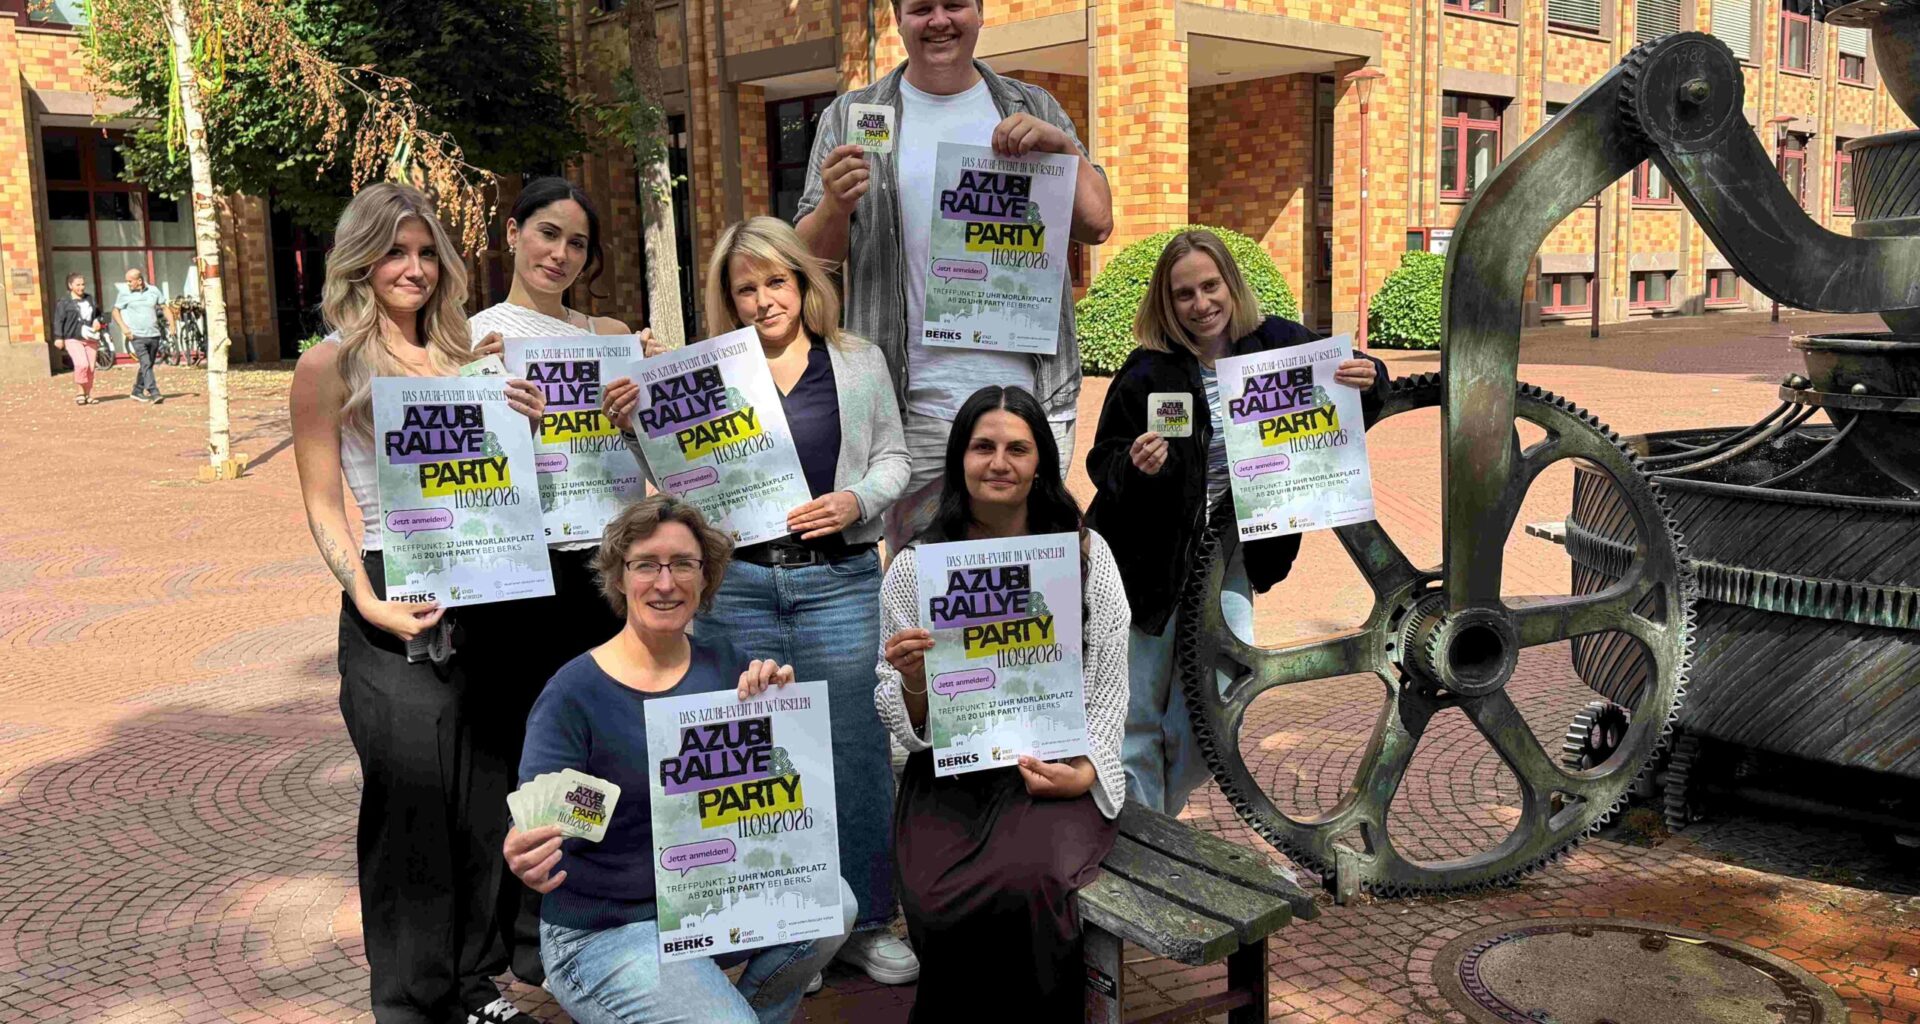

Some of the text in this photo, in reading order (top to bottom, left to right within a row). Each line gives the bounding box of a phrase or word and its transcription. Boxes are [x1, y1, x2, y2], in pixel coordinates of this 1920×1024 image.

[956, 171, 1030, 197] AZUBI
[939, 190, 1028, 217] RALLYE
[964, 221, 1044, 246] PARTY
[990, 248, 1049, 269] 11.09.2026
[1002, 293, 1051, 303] MORLAIXPLATZ
[925, 329, 961, 340] BERKS
[526, 361, 600, 384] AZUBI
[1242, 366, 1312, 396] AZUBI
[402, 390, 417, 401] DAS
[538, 383, 600, 405] LLYE
[650, 365, 723, 406] AZUBI
[638, 387, 726, 433] RALLYE
[1228, 385, 1313, 418] RALLYE
[402, 405, 482, 430] AZUBI
[540, 410, 615, 435] PART
[675, 406, 754, 453] PARTY
[1259, 405, 1335, 440] PARTY
[384, 429, 483, 456] RALLYE
[419, 457, 507, 488] PARTY
[453, 486, 519, 508] 11.09.2026
[710, 501, 726, 510] UHR
[726, 494, 748, 505] PARTY
[725, 488, 741, 497] UHR
[1241, 522, 1277, 534] BERKS
[392, 542, 444, 553] TREFFPUNKT:
[476, 534, 534, 545] MORLAIXPLATZ
[497, 543, 521, 552] BERKS
[945, 555, 961, 567] DAS
[946, 565, 1029, 595] AZUBI
[929, 589, 1029, 622] RALLYE
[964, 615, 1052, 650] PARTY
[996, 643, 1062, 667] 11.09.2026
[956, 675, 989, 685] anmelden!
[679, 696, 810, 724] DAS AZUBI-EVENT IN WÜRSELEN
[938, 702, 987, 715] TREFFPUNKT:
[998, 698, 1014, 706] UHR
[1017, 690, 1072, 704] MORLAIXPLATZ
[978, 710, 995, 718] UHR
[997, 706, 1020, 715] PARTY
[1036, 700, 1060, 710] BERKS
[678, 717, 771, 756] AZUBI
[660, 744, 772, 786] RALLYE
[937, 753, 978, 768] BERKS
[565, 791, 602, 809] RALLYE
[575, 786, 606, 802] AZUBI
[698, 774, 800, 818] PARTY
[572, 806, 606, 822] PARTY
[737, 807, 813, 838] 11.09.2026
[667, 847, 728, 862] Jetzt anmelden!
[667, 862, 826, 893] TREFFPUNKT: 17 UHR MORLAIXPLATZ
[715, 886, 735, 896] UHR
[737, 882, 764, 892] PARTY
[783, 874, 811, 885] BERKS
[663, 935, 713, 953] BERKS
